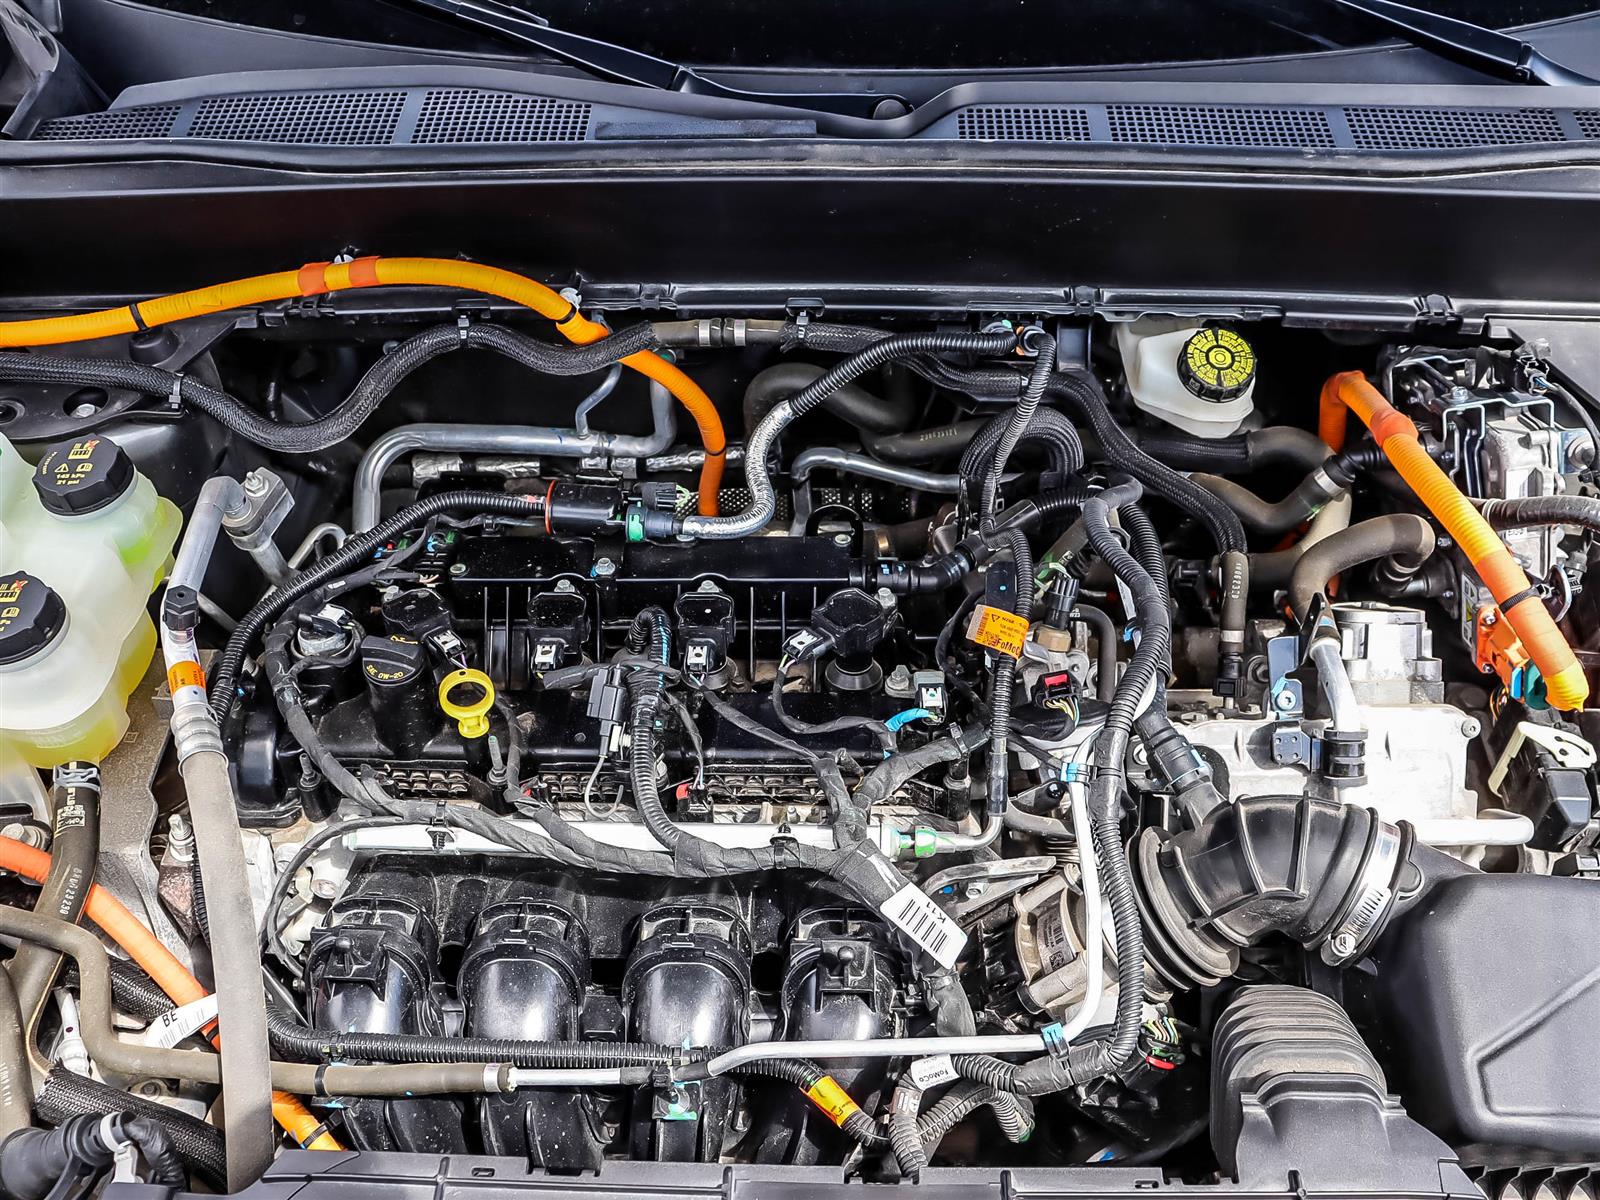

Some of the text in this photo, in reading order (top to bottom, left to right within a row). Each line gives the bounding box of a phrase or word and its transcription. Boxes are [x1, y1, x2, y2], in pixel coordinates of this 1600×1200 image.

[366, 664, 404, 679] SAE 0W-20
[926, 901, 946, 924] K11
[161, 1010, 178, 1028] BE
